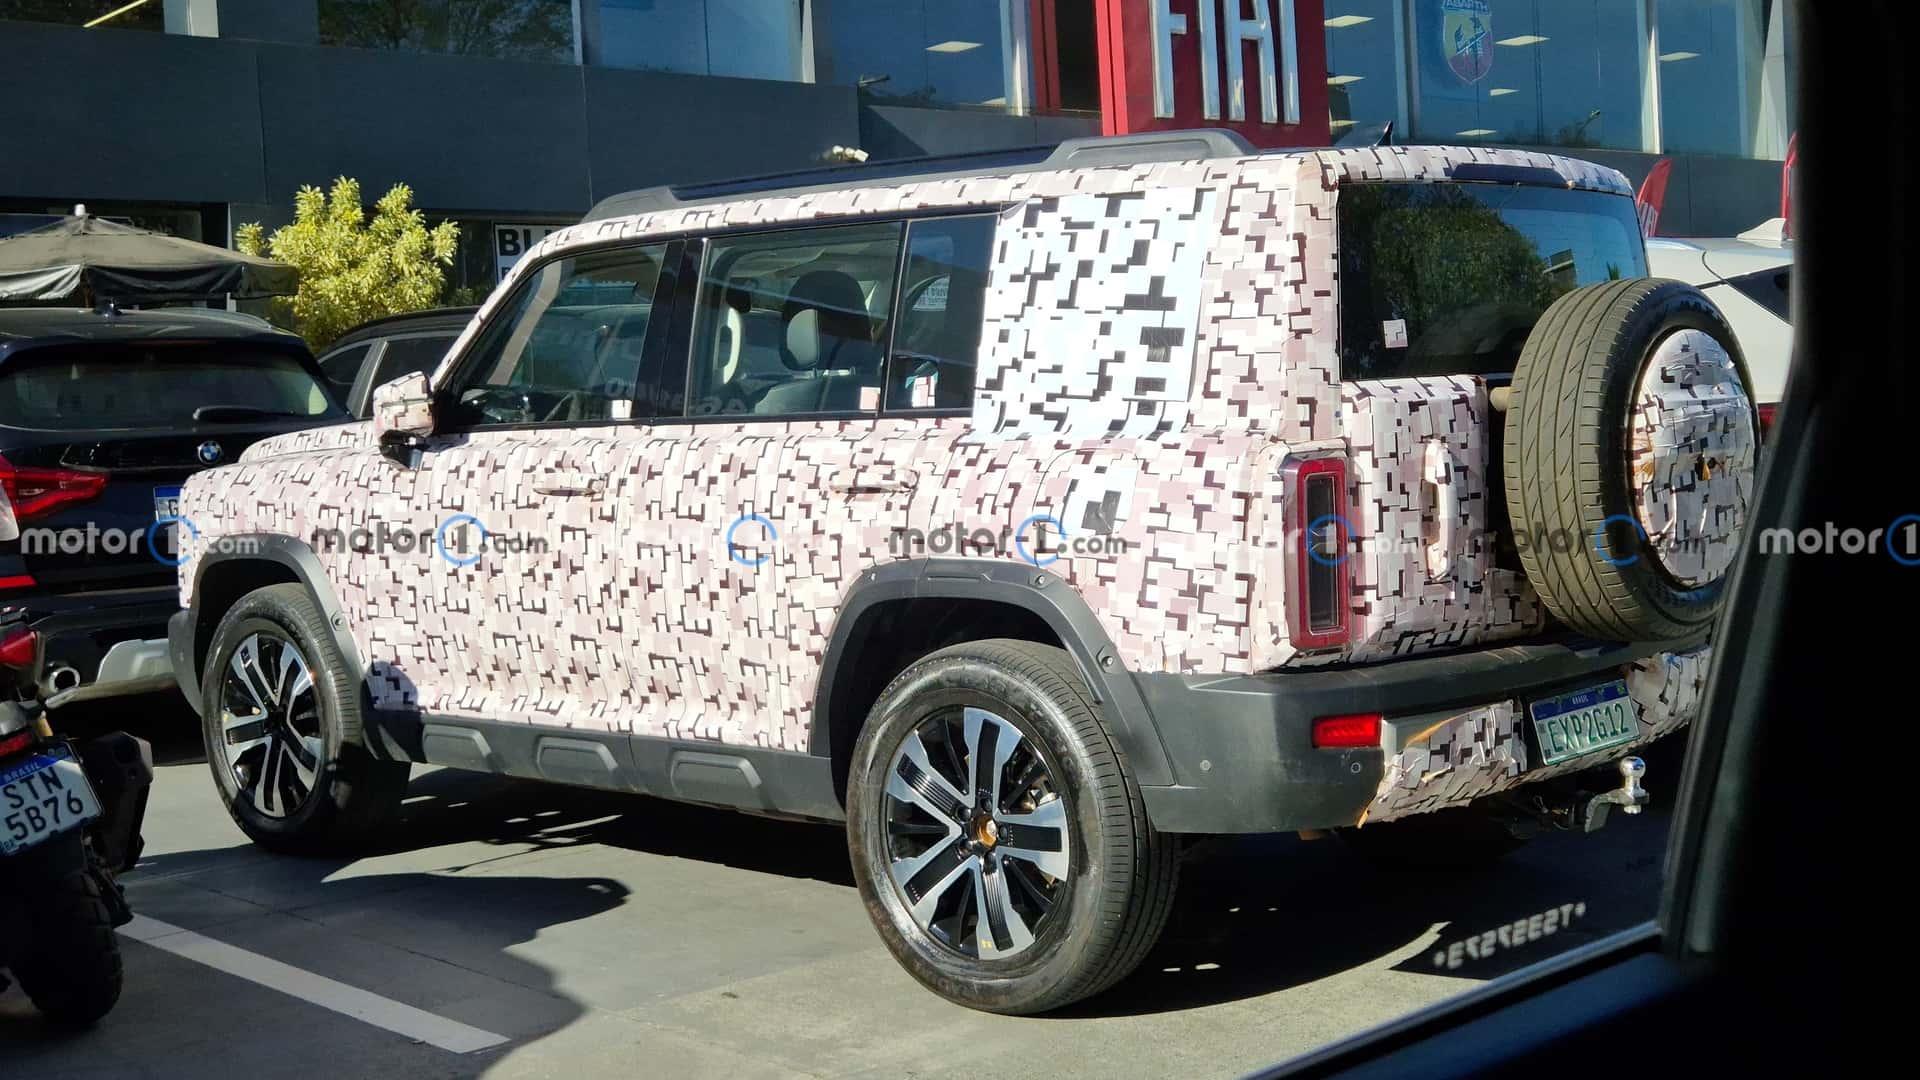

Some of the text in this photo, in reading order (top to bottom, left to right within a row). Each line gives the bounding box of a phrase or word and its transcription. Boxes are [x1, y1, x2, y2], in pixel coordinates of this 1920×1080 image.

[1547, 703, 1628, 752] EXP2G12
[3, 766, 63, 809] STN
[5, 788, 84, 841] 5B76
